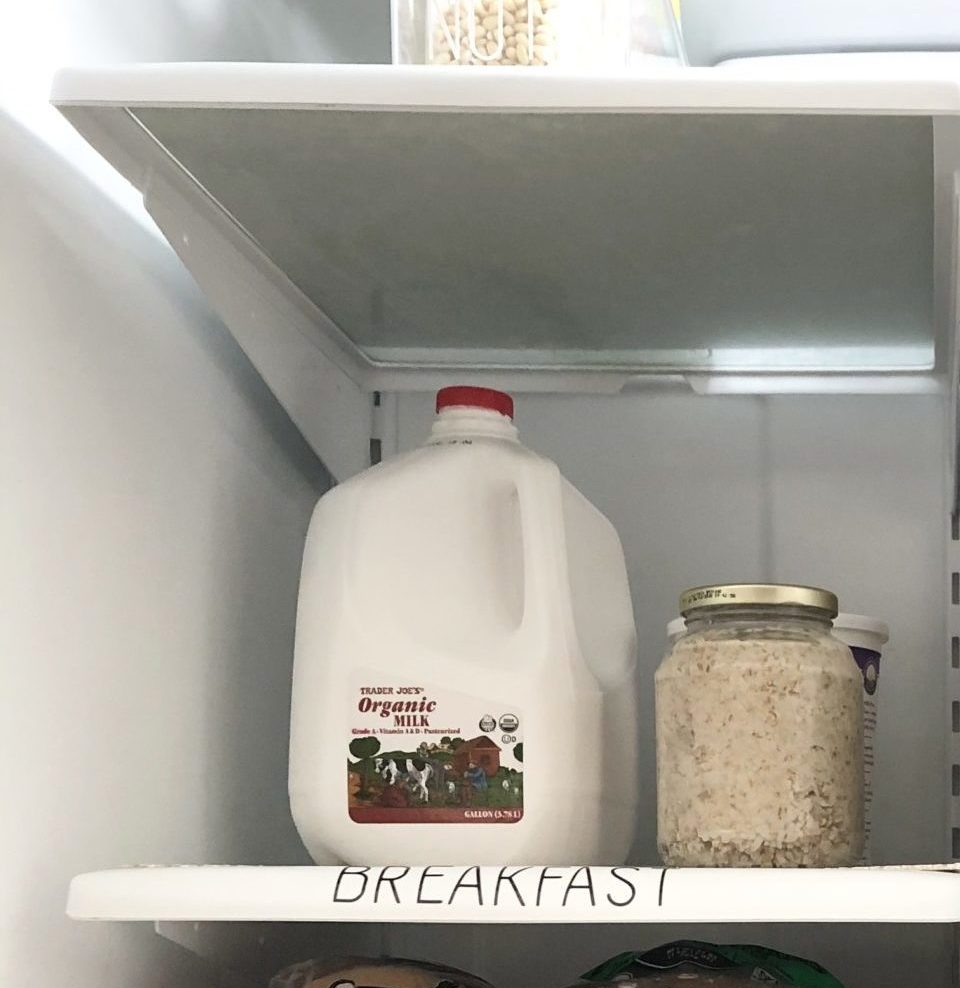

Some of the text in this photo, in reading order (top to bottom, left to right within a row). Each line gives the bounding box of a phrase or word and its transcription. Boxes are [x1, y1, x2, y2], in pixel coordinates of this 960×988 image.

[360, 687, 393, 695] TRADER
[358, 697, 437, 718] Organic
[394, 715, 430, 727] MILK
[464, 810, 493, 818] GALLON
[333, 866, 673, 907] BREAKFAST
